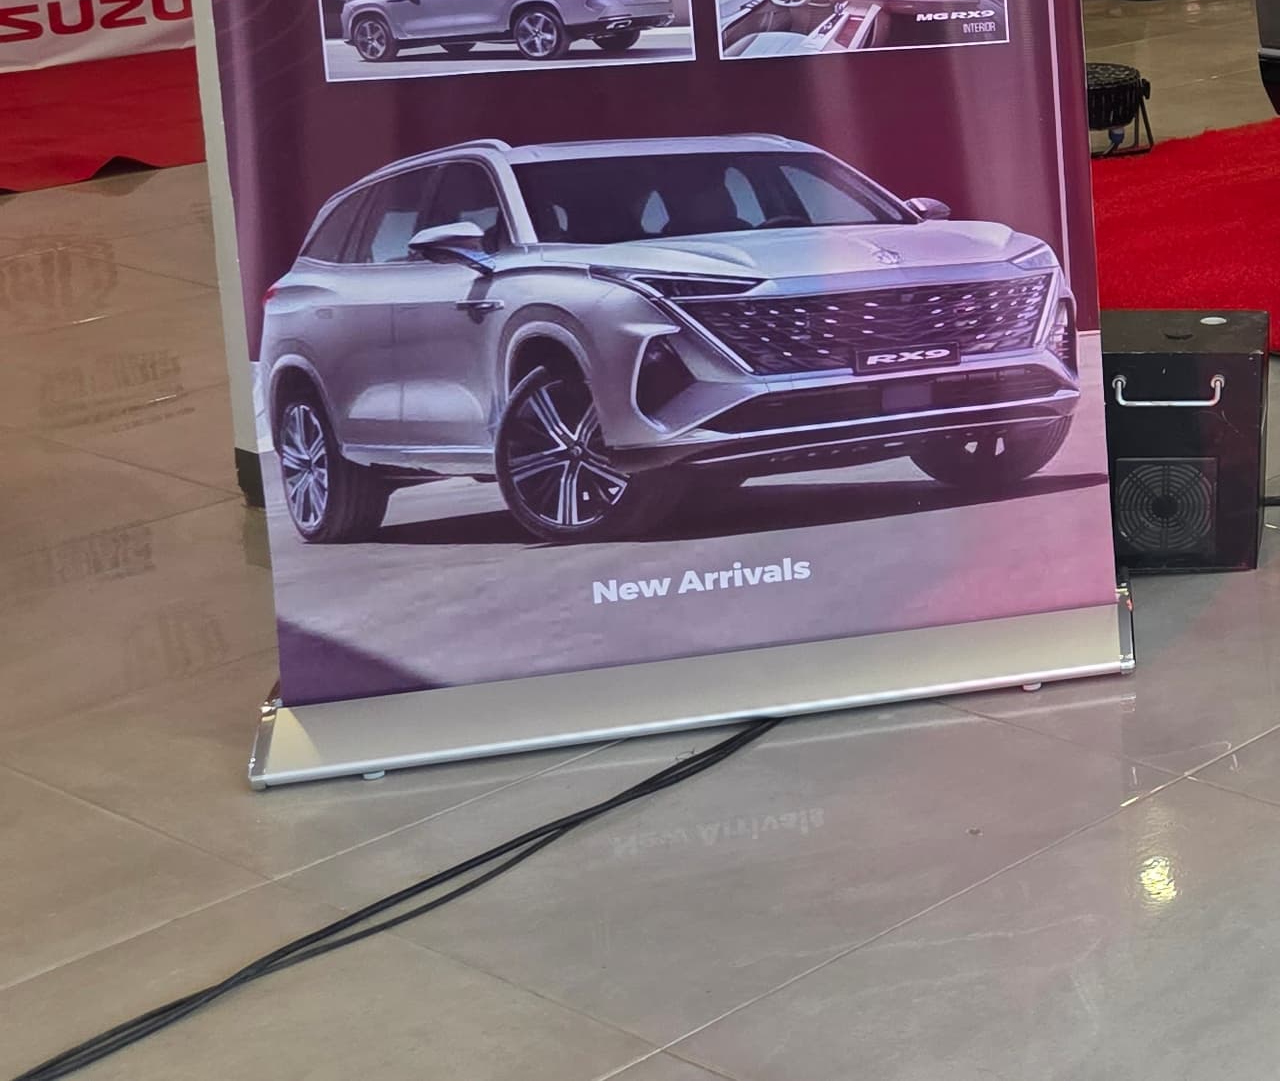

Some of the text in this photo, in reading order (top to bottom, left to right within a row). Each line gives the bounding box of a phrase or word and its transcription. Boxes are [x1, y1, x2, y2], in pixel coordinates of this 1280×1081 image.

[916, 9, 995, 22] MG RX9
[962, 21, 996, 33] INTERIOR
[866, 348, 950, 365] RX9
[592, 557, 812, 604] New Arrivals
